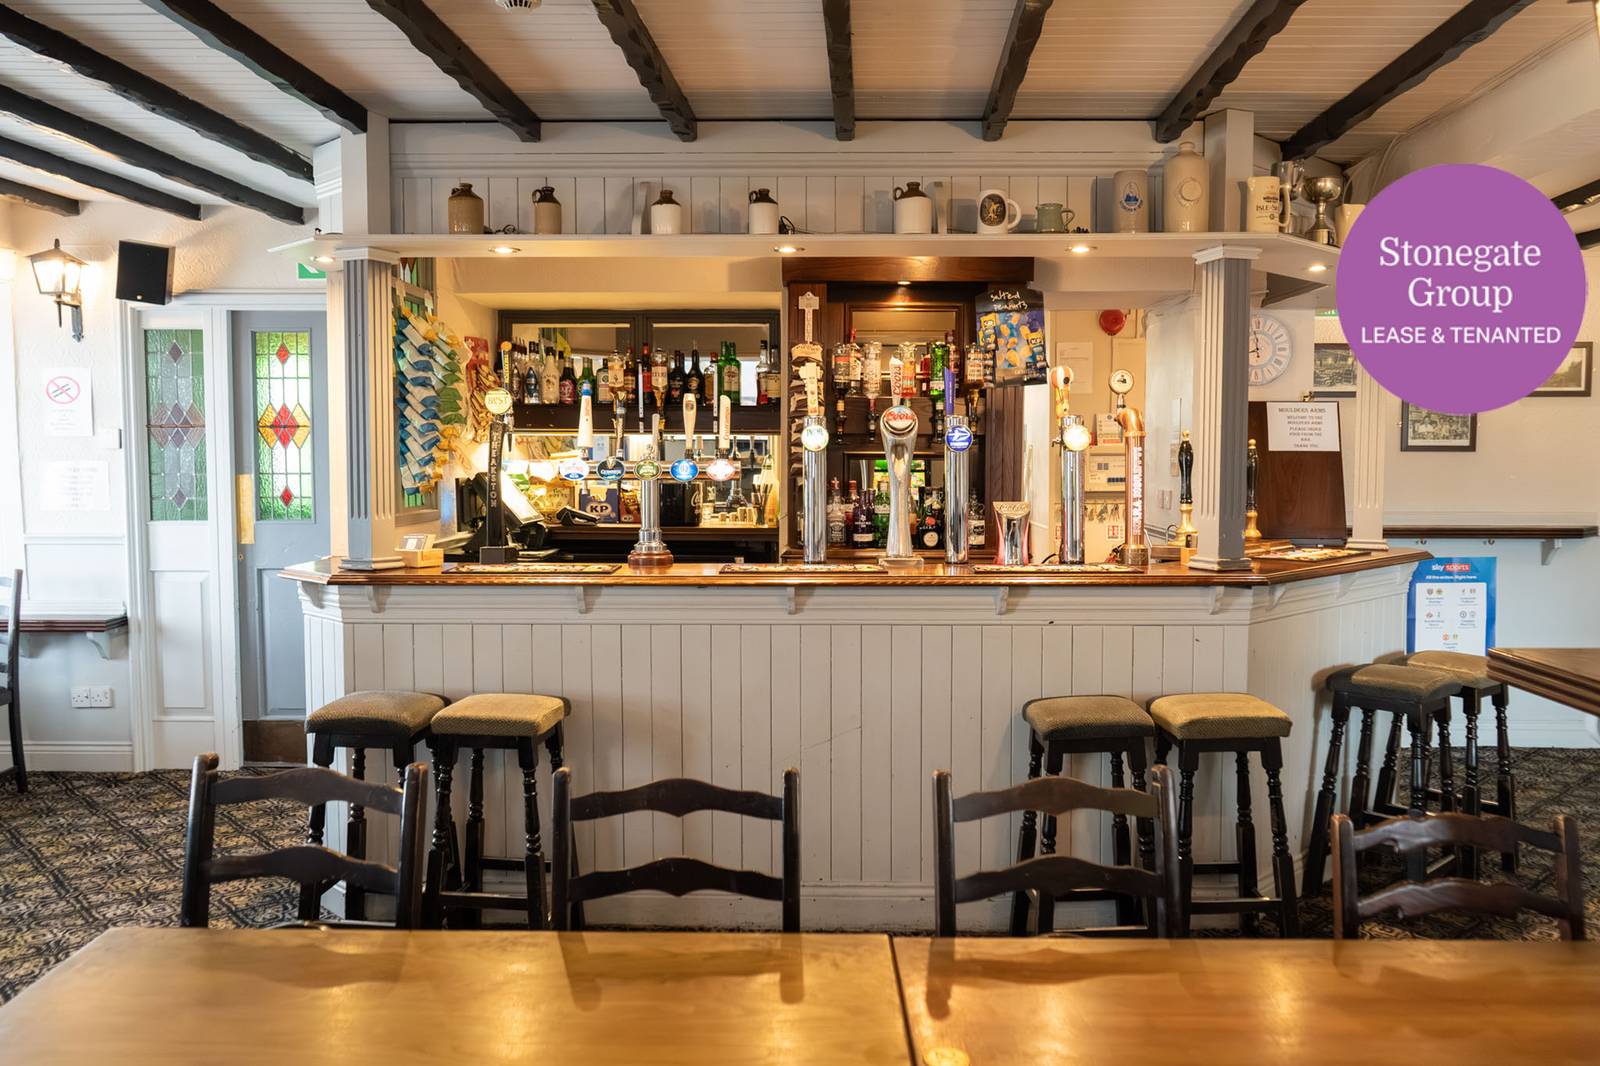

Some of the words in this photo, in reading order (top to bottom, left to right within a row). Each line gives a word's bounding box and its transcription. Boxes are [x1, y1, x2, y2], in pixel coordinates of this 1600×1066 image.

[885, 410, 914, 421] Coors
[589, 504, 609, 513] KP
[1432, 563, 1445, 572] sky
